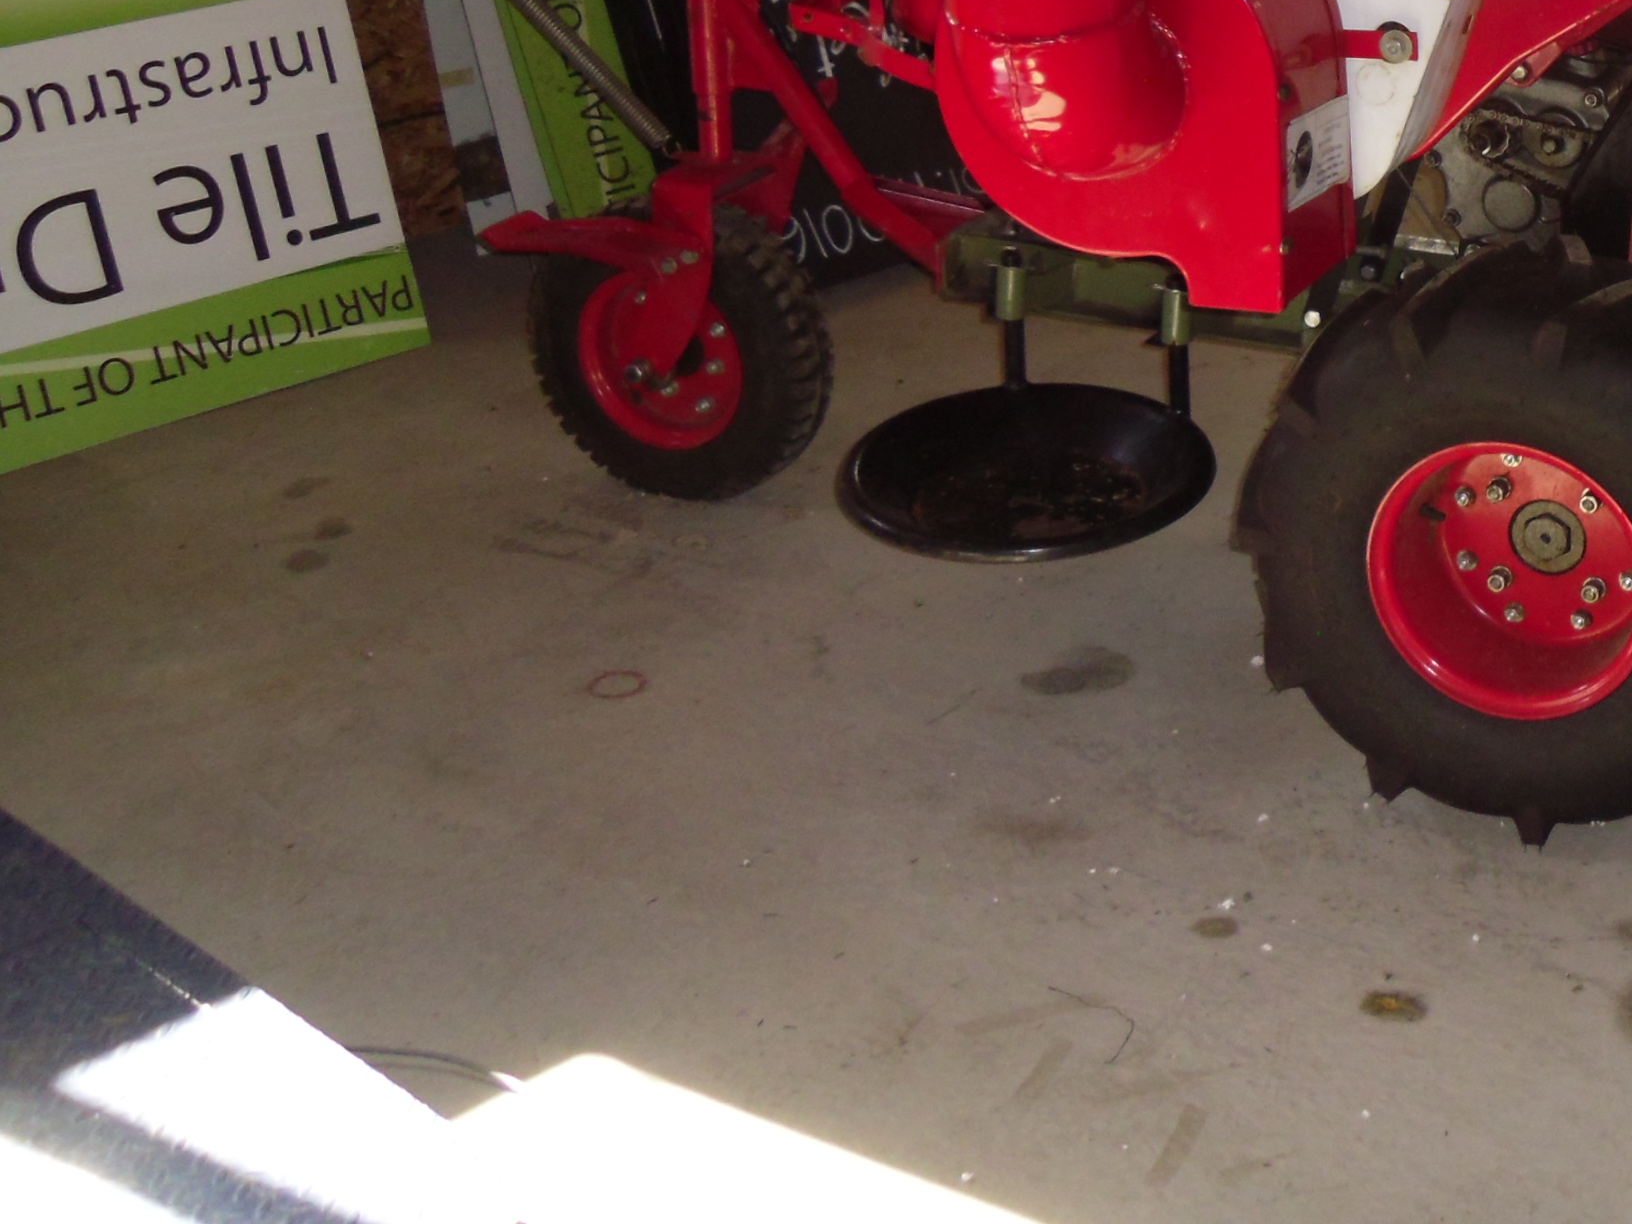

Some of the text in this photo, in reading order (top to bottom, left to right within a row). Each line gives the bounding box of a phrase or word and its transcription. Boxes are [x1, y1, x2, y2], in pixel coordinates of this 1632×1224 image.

[0, 131, 381, 306] Tile D
[72, 356, 136, 407] OF
[150, 275, 415, 387] PARTICIPANT
